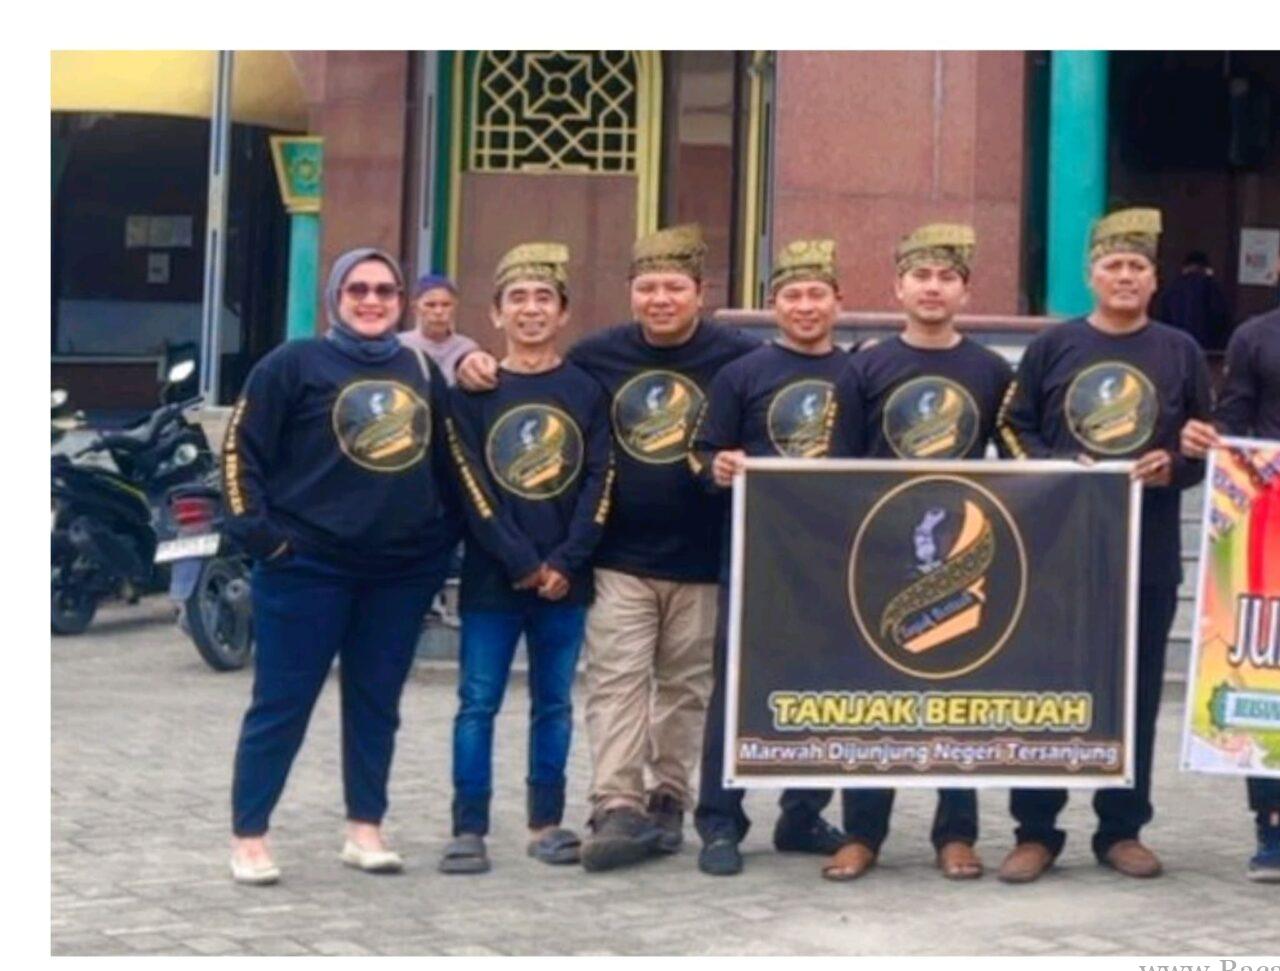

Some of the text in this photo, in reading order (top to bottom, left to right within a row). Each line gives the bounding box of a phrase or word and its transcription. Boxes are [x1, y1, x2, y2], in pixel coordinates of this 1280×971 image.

[771, 694, 1090, 729] TANJAK BERTUAH
[740, 743, 1118, 769] Marwah Dijunjung Negeri Tersanjung
